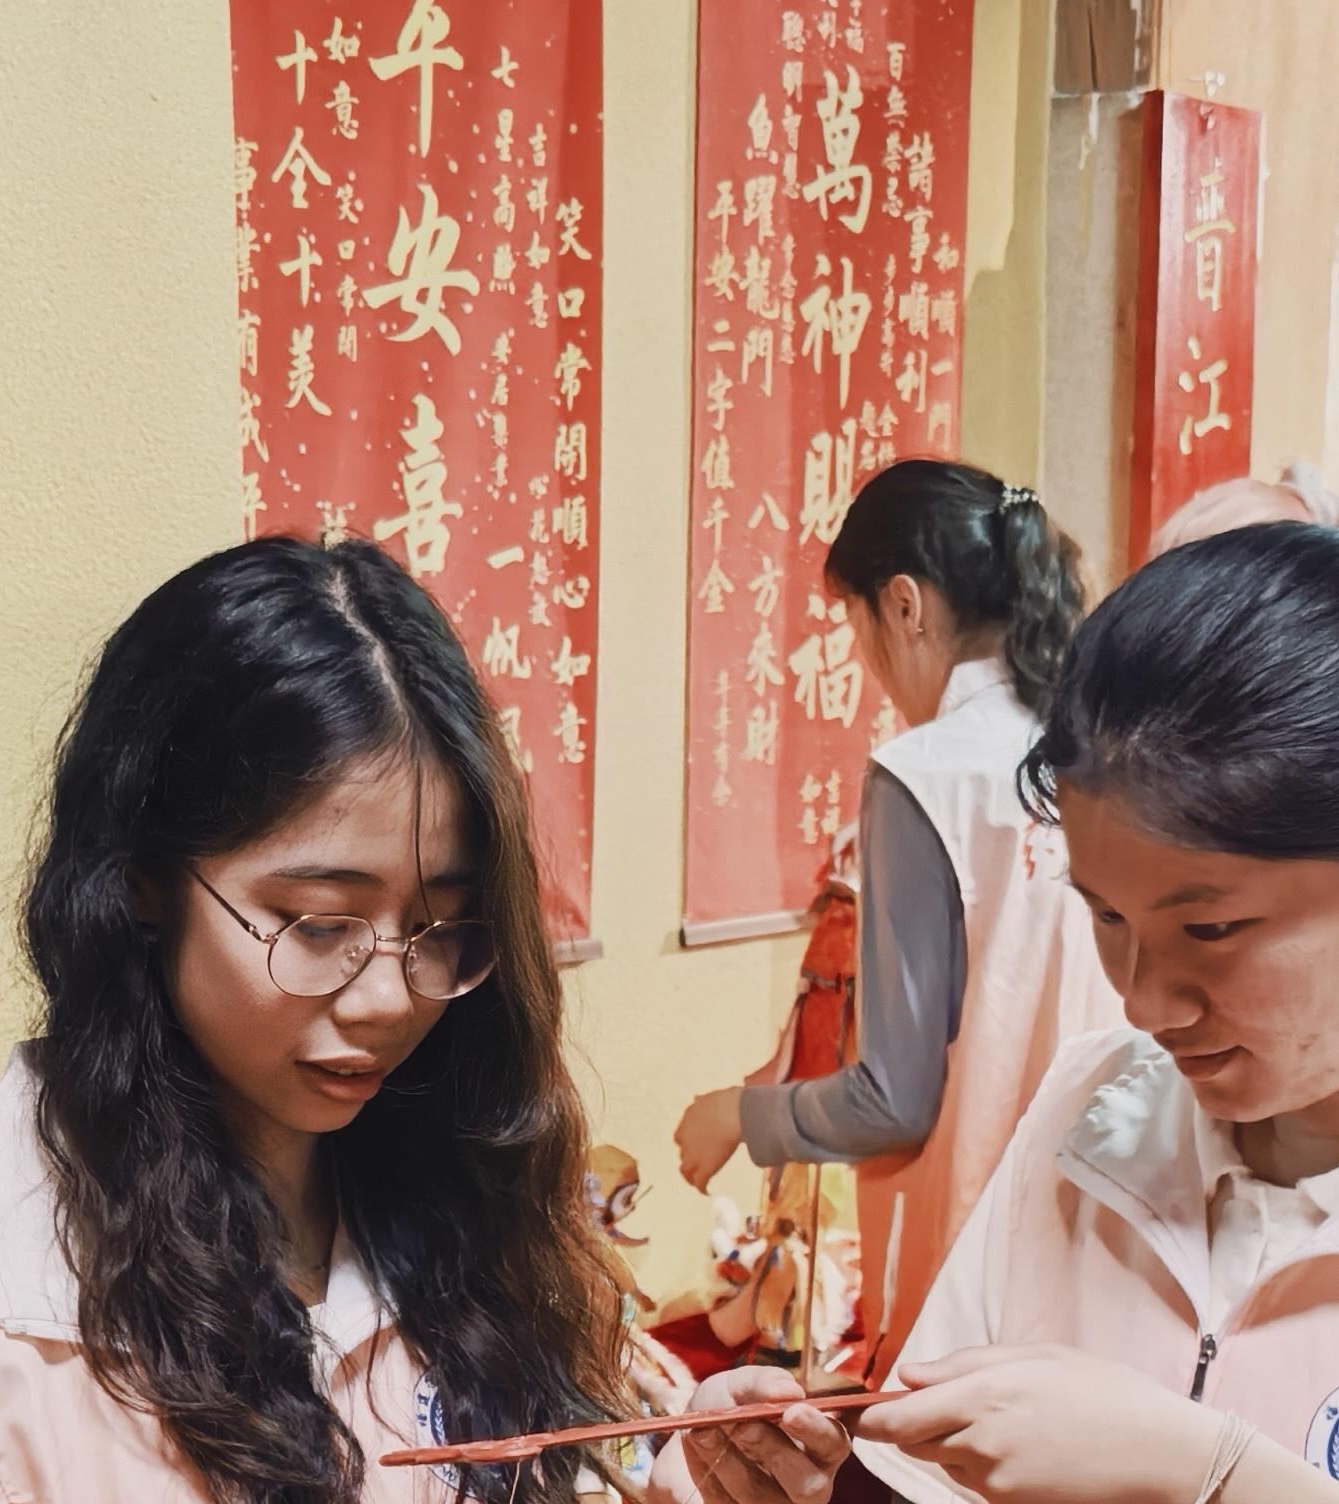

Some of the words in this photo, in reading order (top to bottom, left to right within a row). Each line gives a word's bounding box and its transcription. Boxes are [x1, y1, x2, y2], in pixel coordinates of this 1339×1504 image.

[271, 29, 332, 416] 十全十美
[489, 46, 518, 295] 七星高照
[525, 122, 551, 328] 吉祥如意
